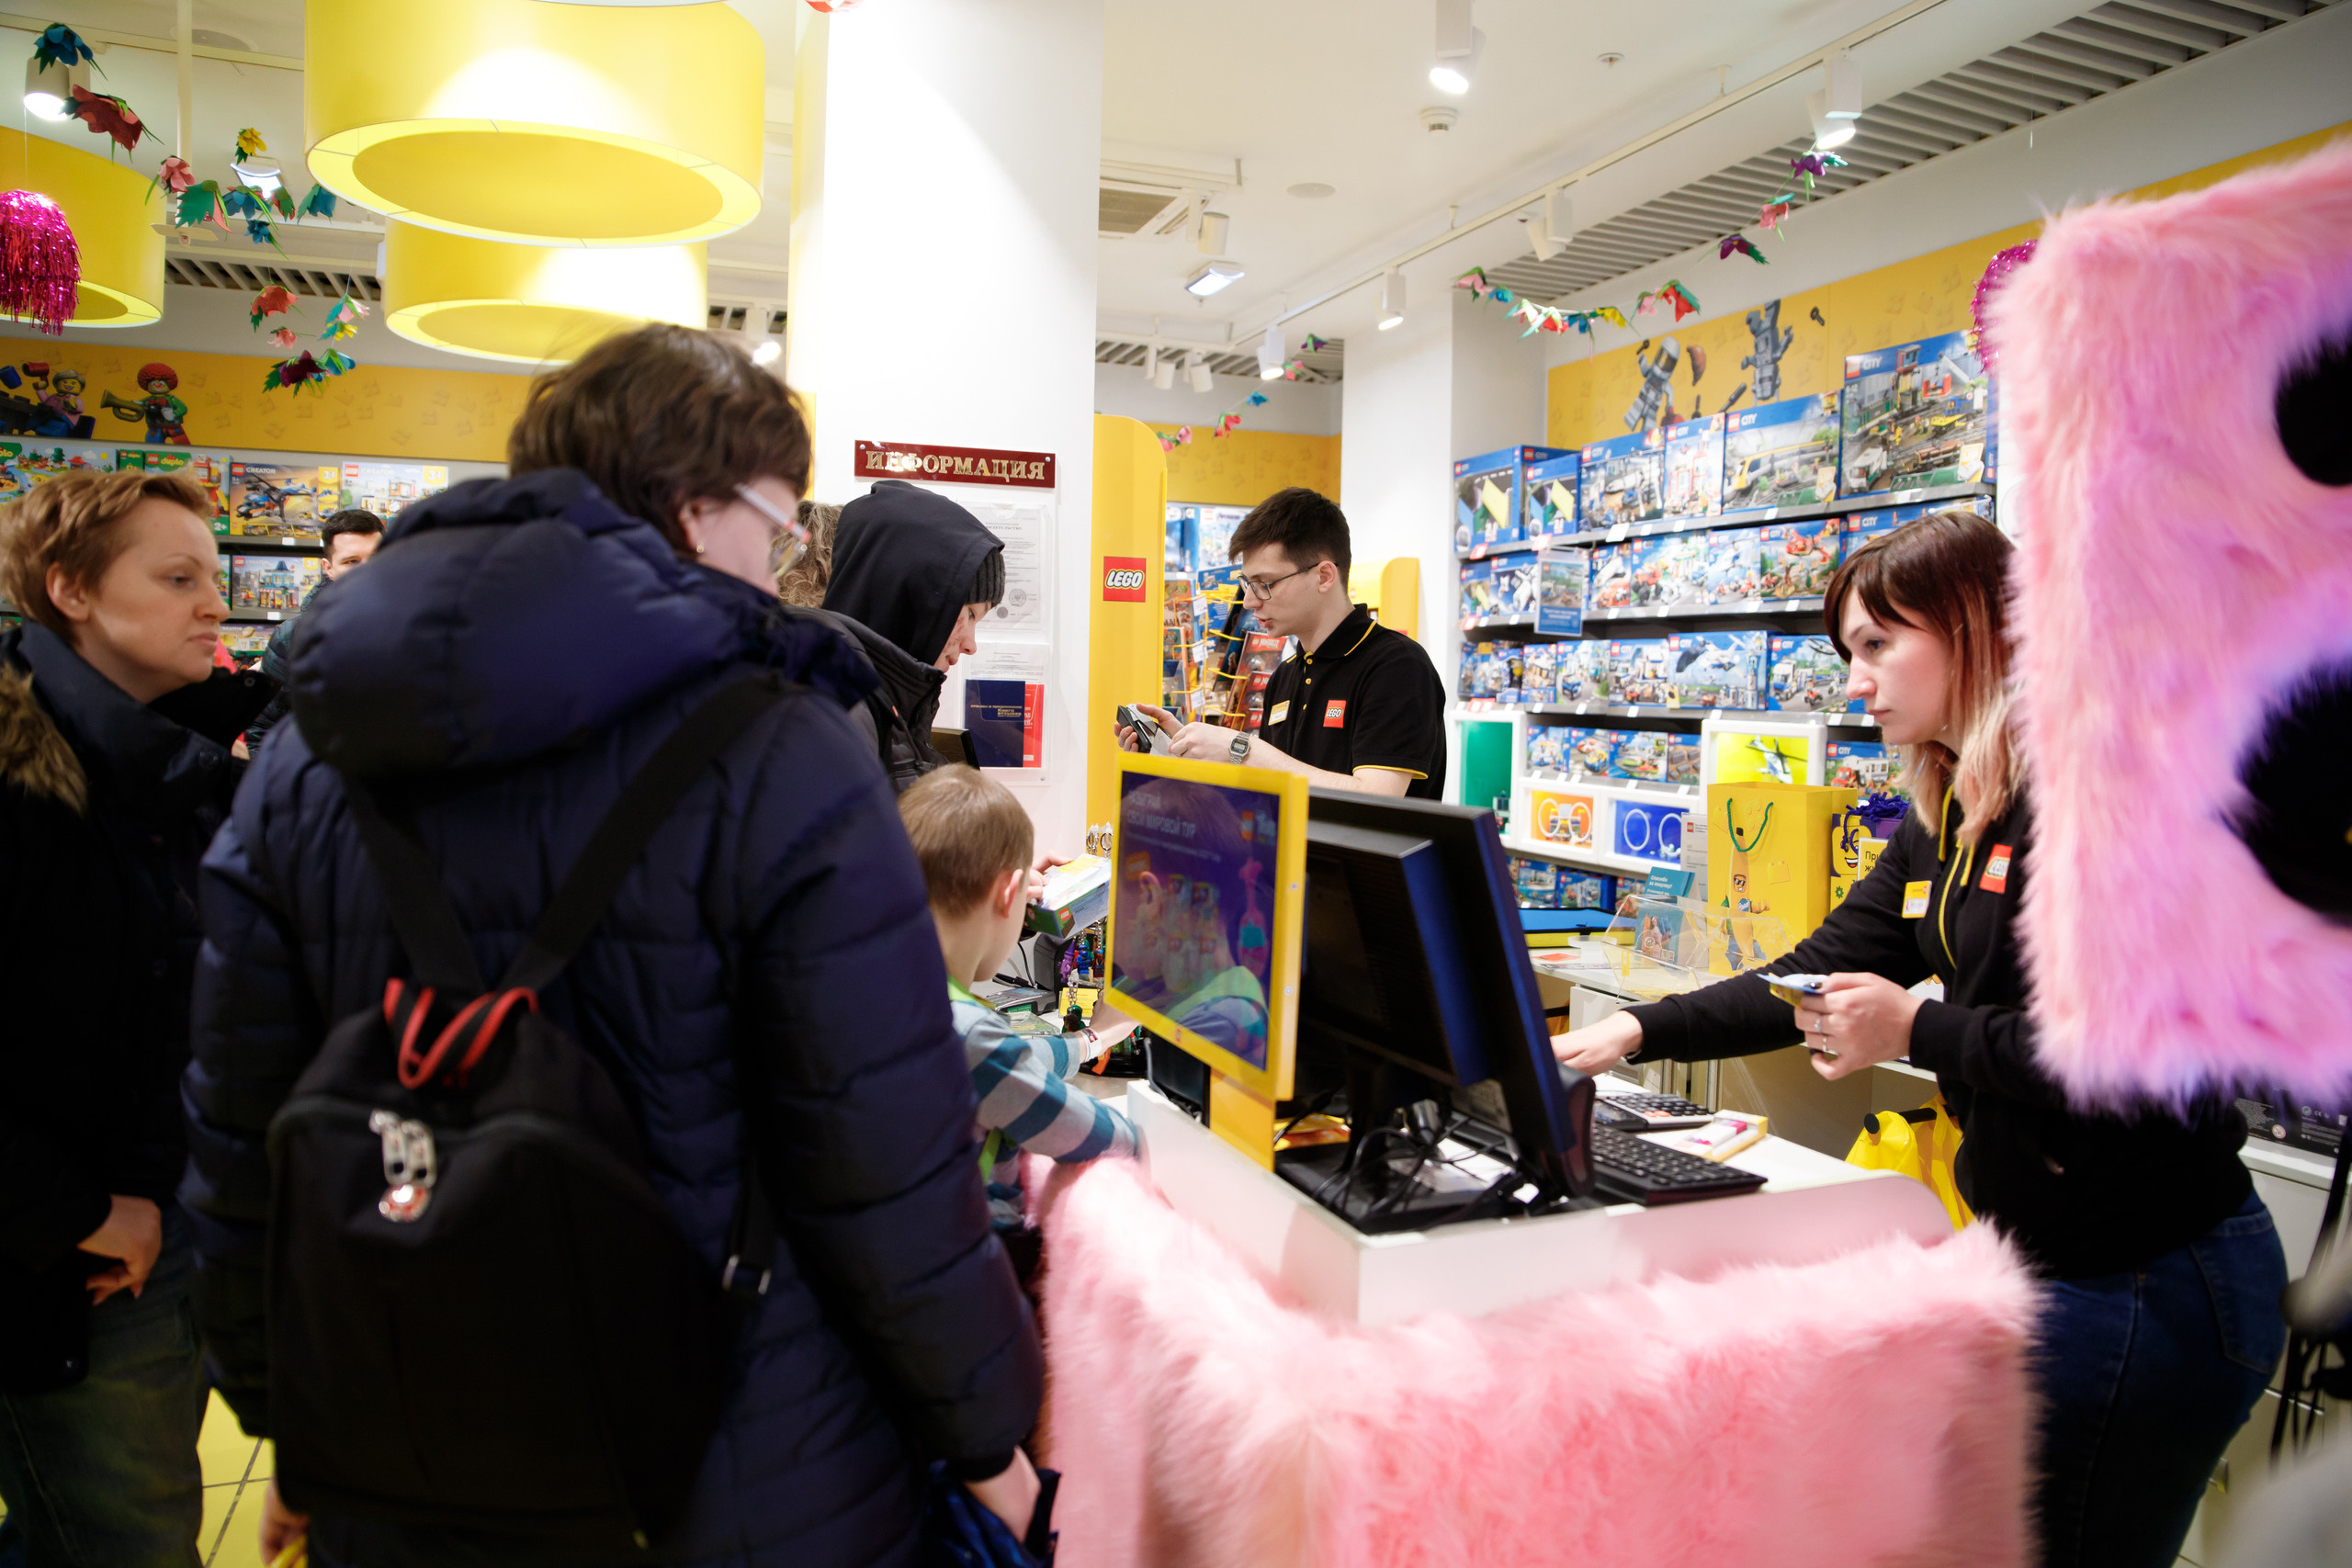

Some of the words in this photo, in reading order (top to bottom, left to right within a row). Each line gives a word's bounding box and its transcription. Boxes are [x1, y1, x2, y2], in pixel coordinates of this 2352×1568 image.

[1863, 356, 1883, 369] CITY
[1741, 413, 1757, 425] CITY
[160, 457, 184, 467] duplo
[865, 450, 1045, 483] ИНФОРМАЦИЯ
[245, 467, 276, 475] CREATOR
[213, 522, 227, 531] 2+
[1862, 516, 1878, 527] CITY
[1105, 569, 1145, 590] LEGO
[1326, 707, 1342, 719] LEGO
[1838, 747, 1851, 755] CITY
